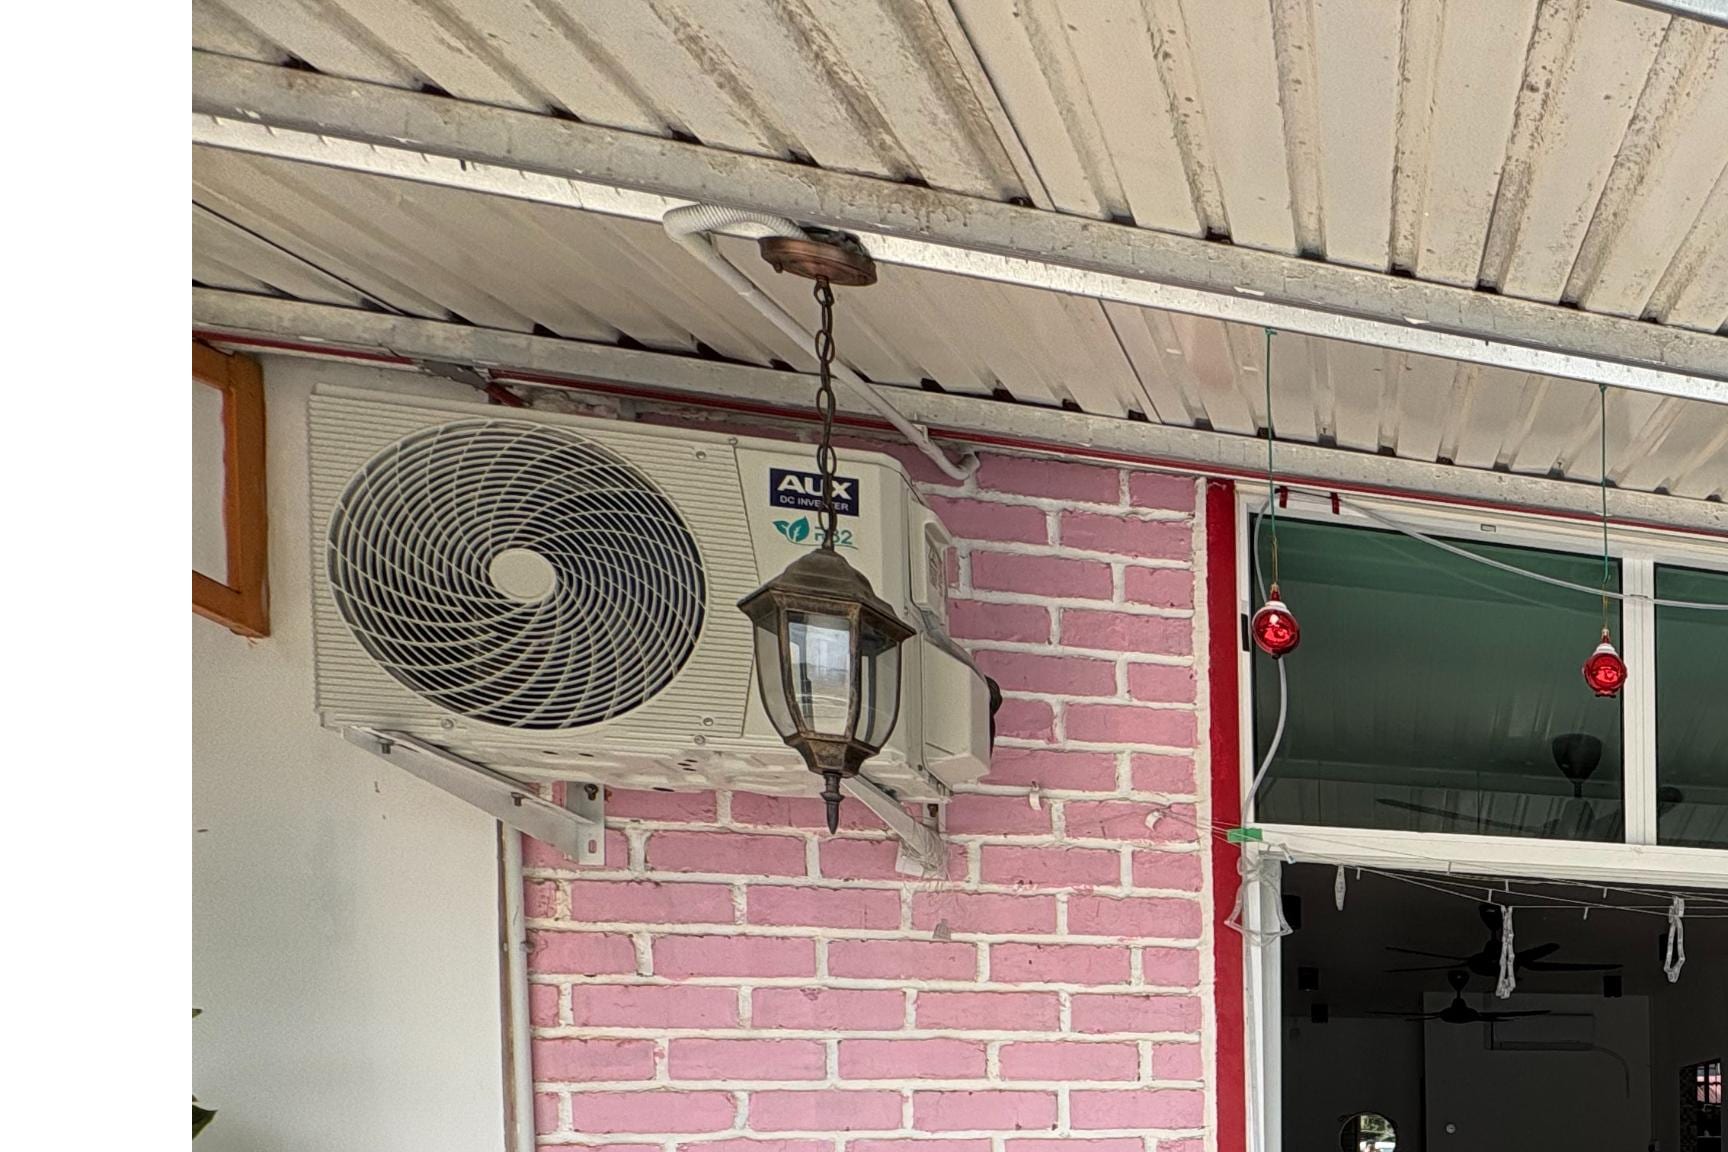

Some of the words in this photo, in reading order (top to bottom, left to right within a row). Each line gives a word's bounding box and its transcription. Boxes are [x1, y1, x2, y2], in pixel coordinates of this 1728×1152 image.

[777, 474, 852, 500] AUX
[779, 495, 796, 505] DC
[797, 497, 849, 512] INVEER
